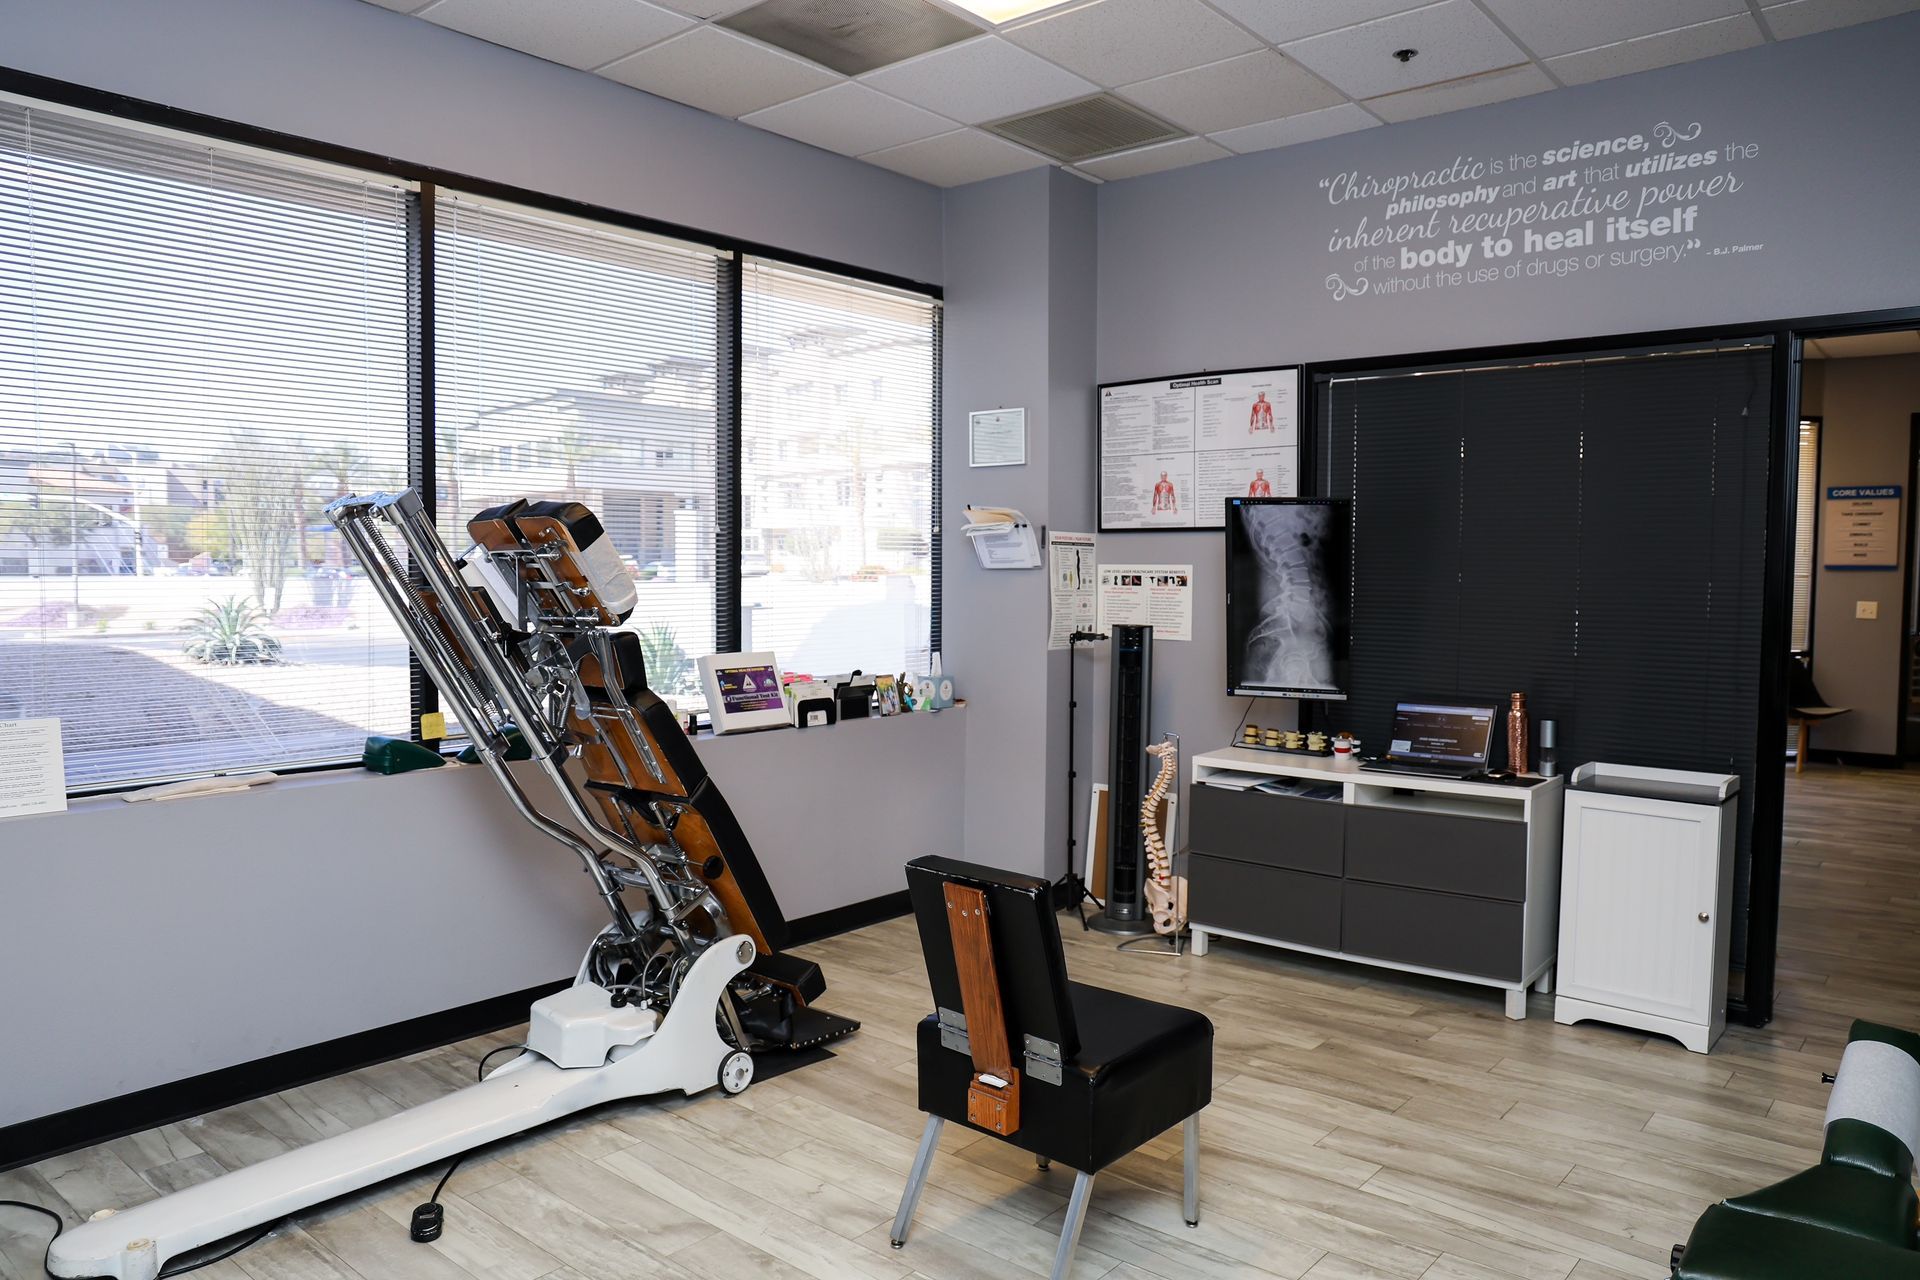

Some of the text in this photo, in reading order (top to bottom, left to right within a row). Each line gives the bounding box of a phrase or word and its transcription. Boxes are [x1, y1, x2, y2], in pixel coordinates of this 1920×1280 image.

[1385, 140, 1759, 220] philosophy and art that utilizes the
[1490, 157, 1504, 176] is
[1509, 153, 1537, 171] the
[1541, 133, 1650, 166] science,
[1328, 171, 1744, 253] inherent recuperative power
[1354, 205, 1698, 274] of the body to heal itself
[1373, 275, 1430, 295] without
[1435, 271, 1461, 289] the
[1467, 266, 1499, 284] use
[1504, 260, 1522, 279] of
[1526, 254, 1579, 277] drugs
[1585, 251, 1603, 269] or
[1713, 246, 1730, 256] B.J.
[1732, 242, 1764, 254] Palmer
